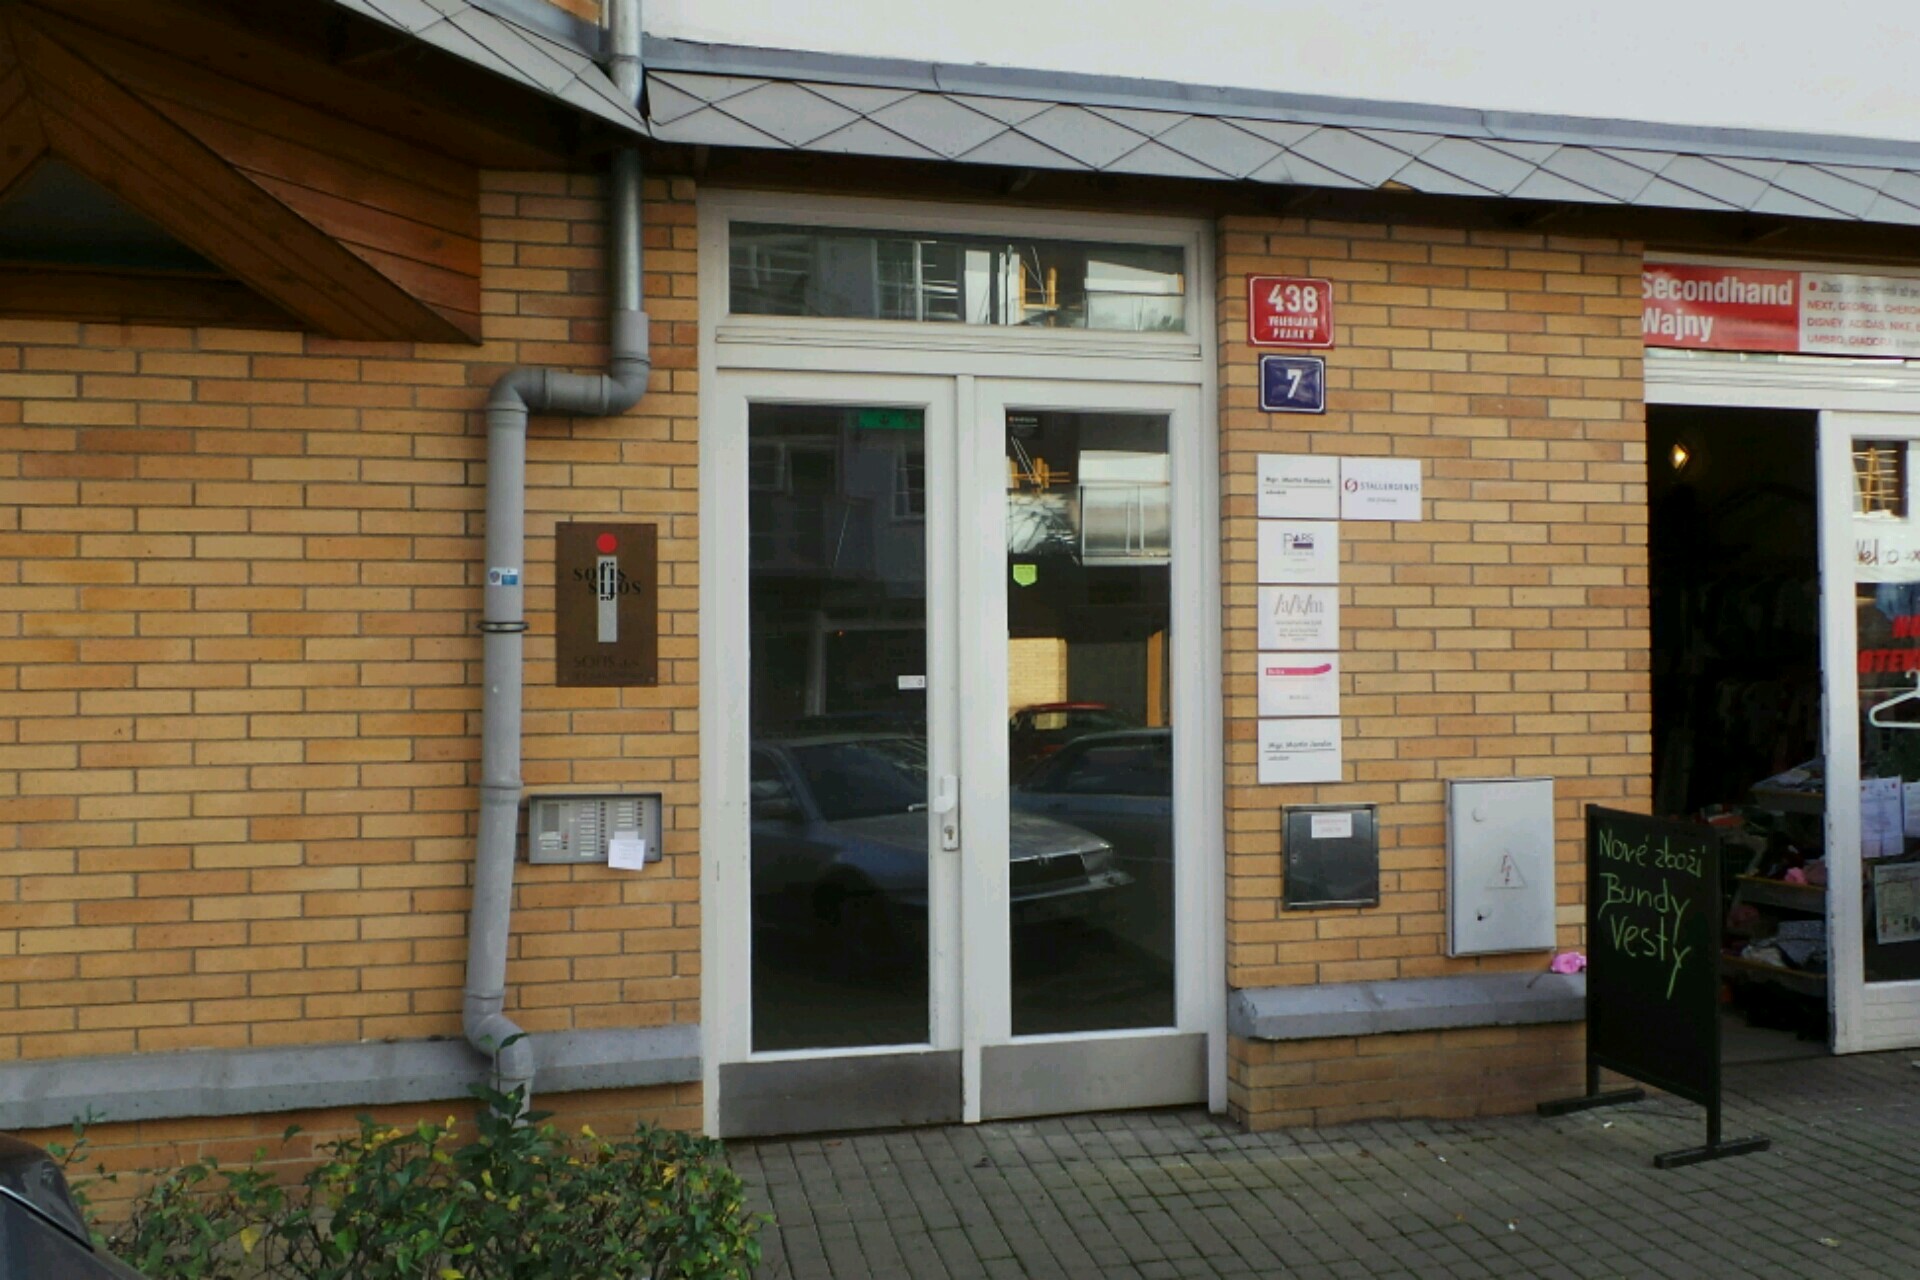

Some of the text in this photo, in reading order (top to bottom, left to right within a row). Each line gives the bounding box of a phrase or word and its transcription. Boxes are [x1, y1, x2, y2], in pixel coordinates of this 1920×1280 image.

[1267, 283, 1318, 313] 438
[1642, 272, 1793, 305] Secondhand
[1642, 308, 1714, 343] Wajny
[1286, 368, 1302, 399] 7
[1599, 829, 1649, 867] Nové
[1598, 873, 1690, 946] Bundy
[1610, 915, 1692, 1000] Vesty
